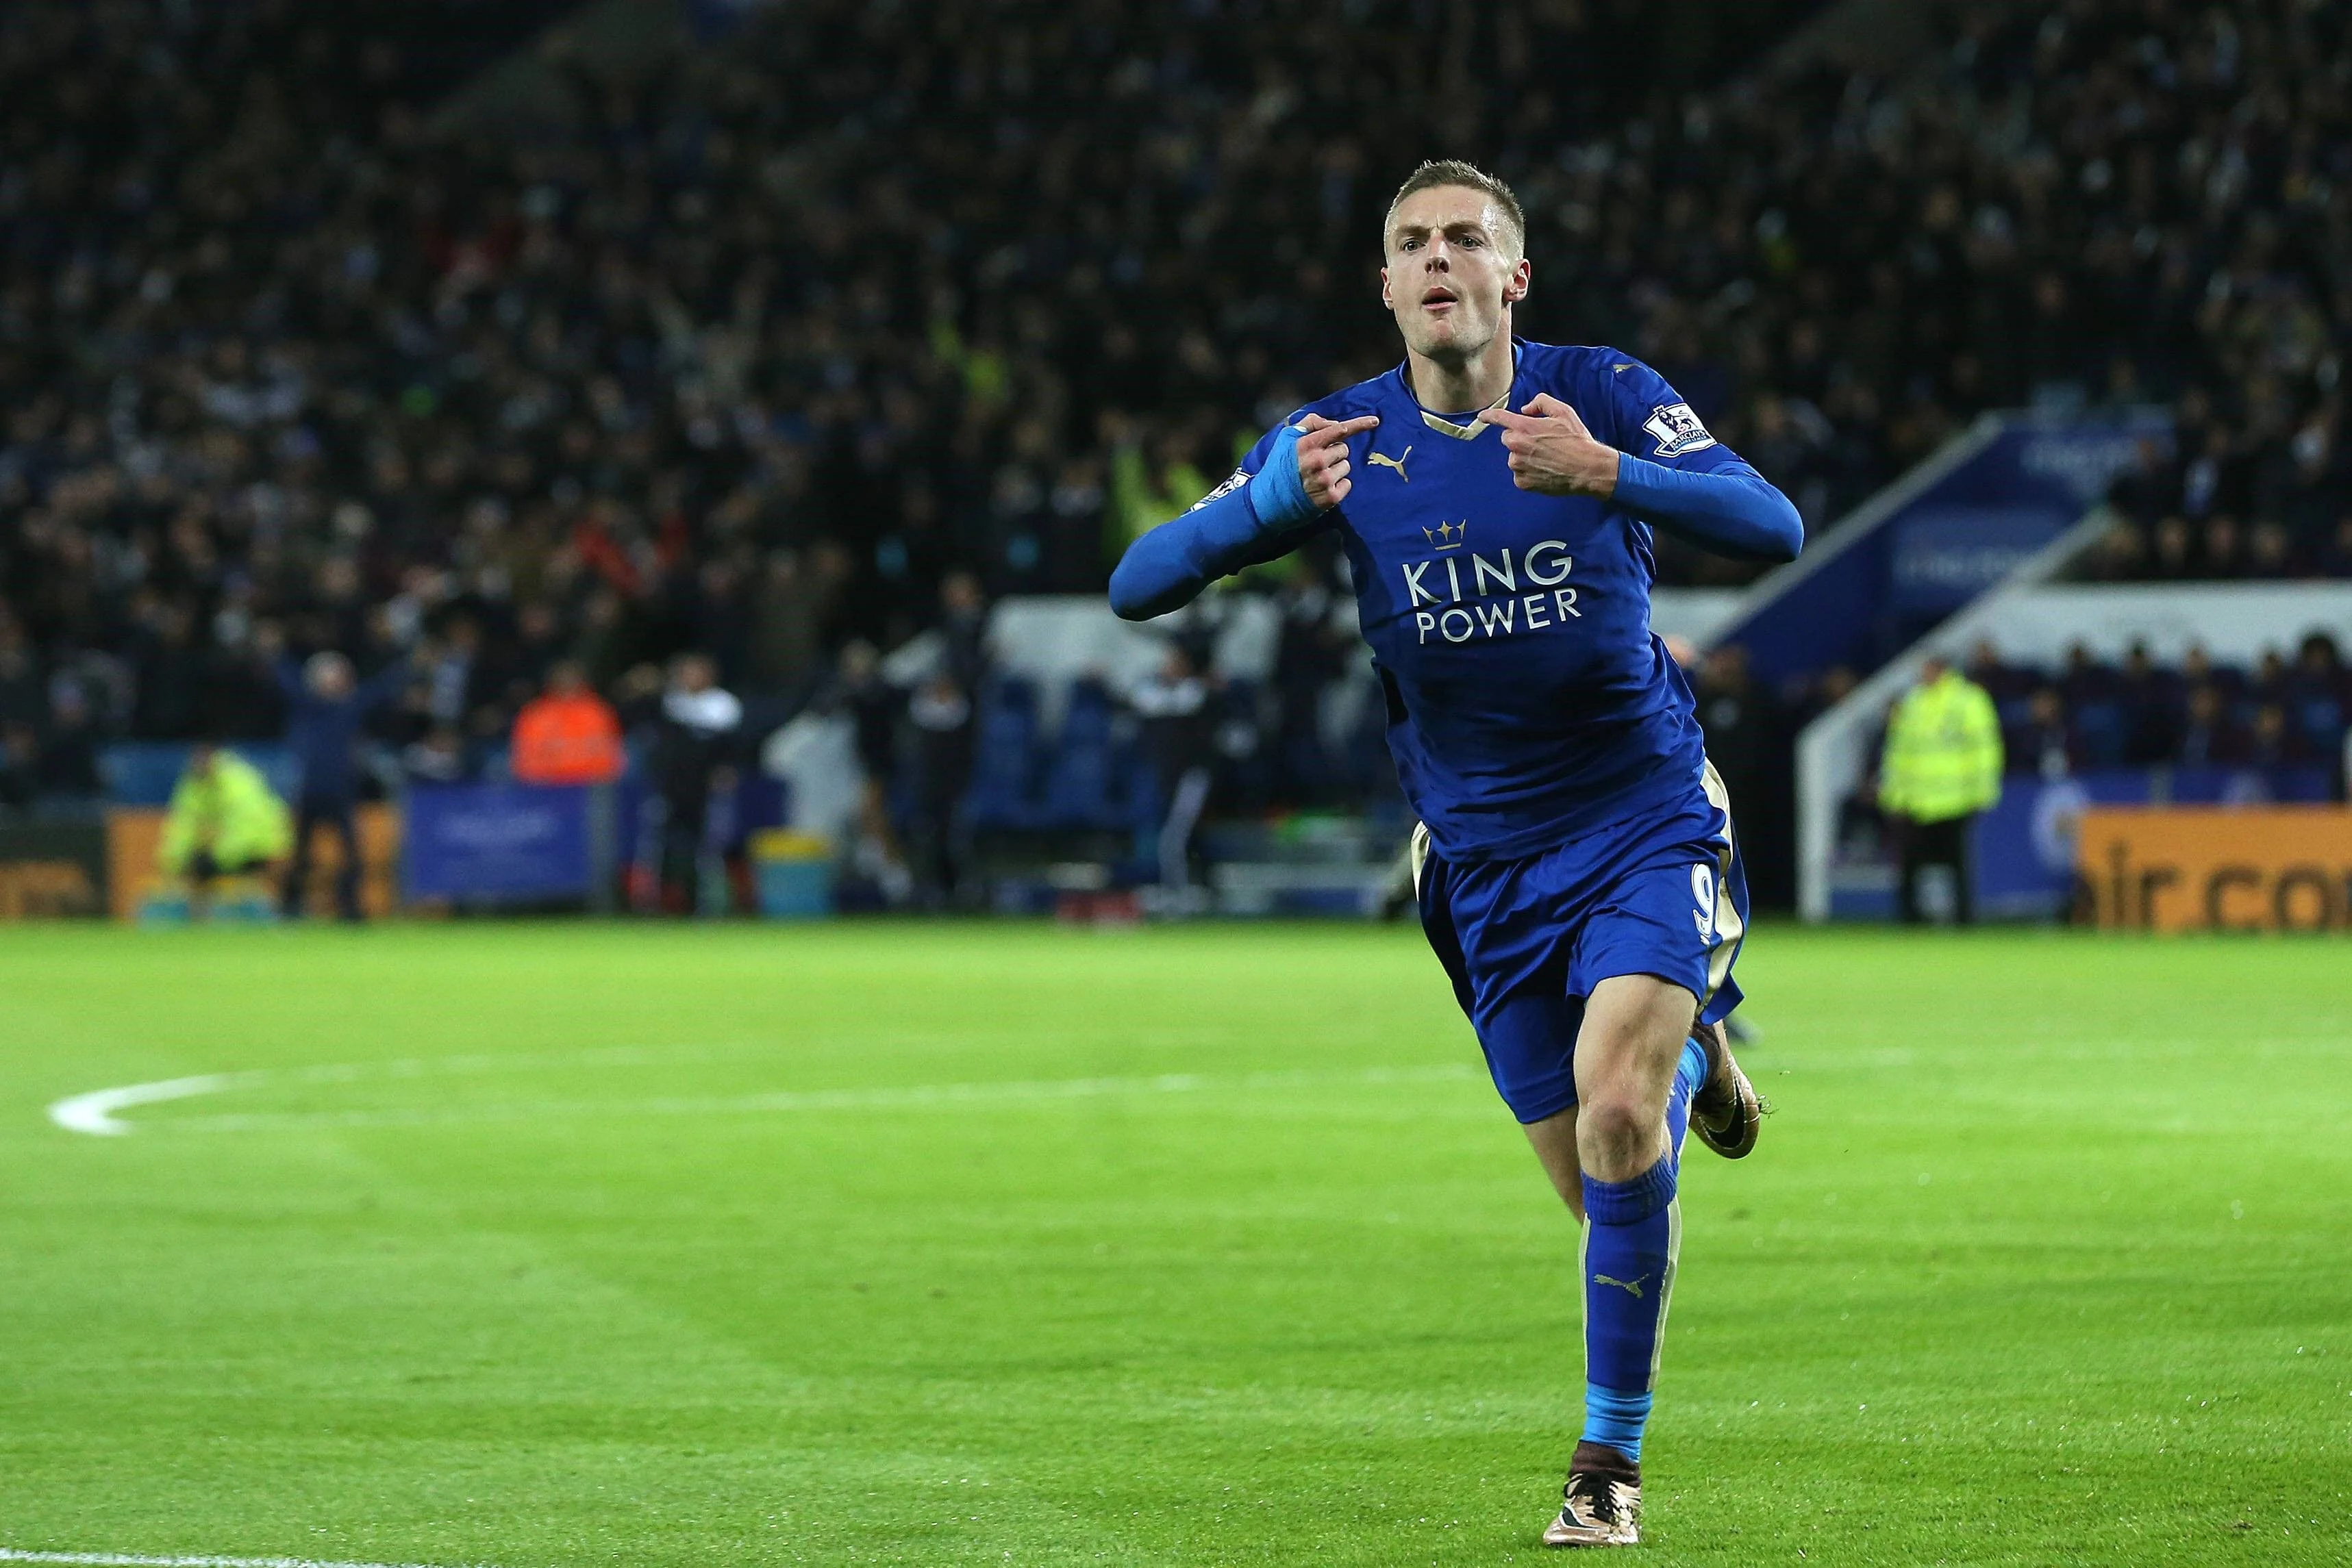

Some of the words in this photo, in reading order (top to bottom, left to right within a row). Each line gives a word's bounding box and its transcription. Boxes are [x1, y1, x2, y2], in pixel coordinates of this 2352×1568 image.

[1669, 430, 1706, 448] BARCLAYS
[1402, 540, 1572, 607] KING
[1416, 587, 1582, 644] POWER
[1690, 863, 1714, 937] 9
